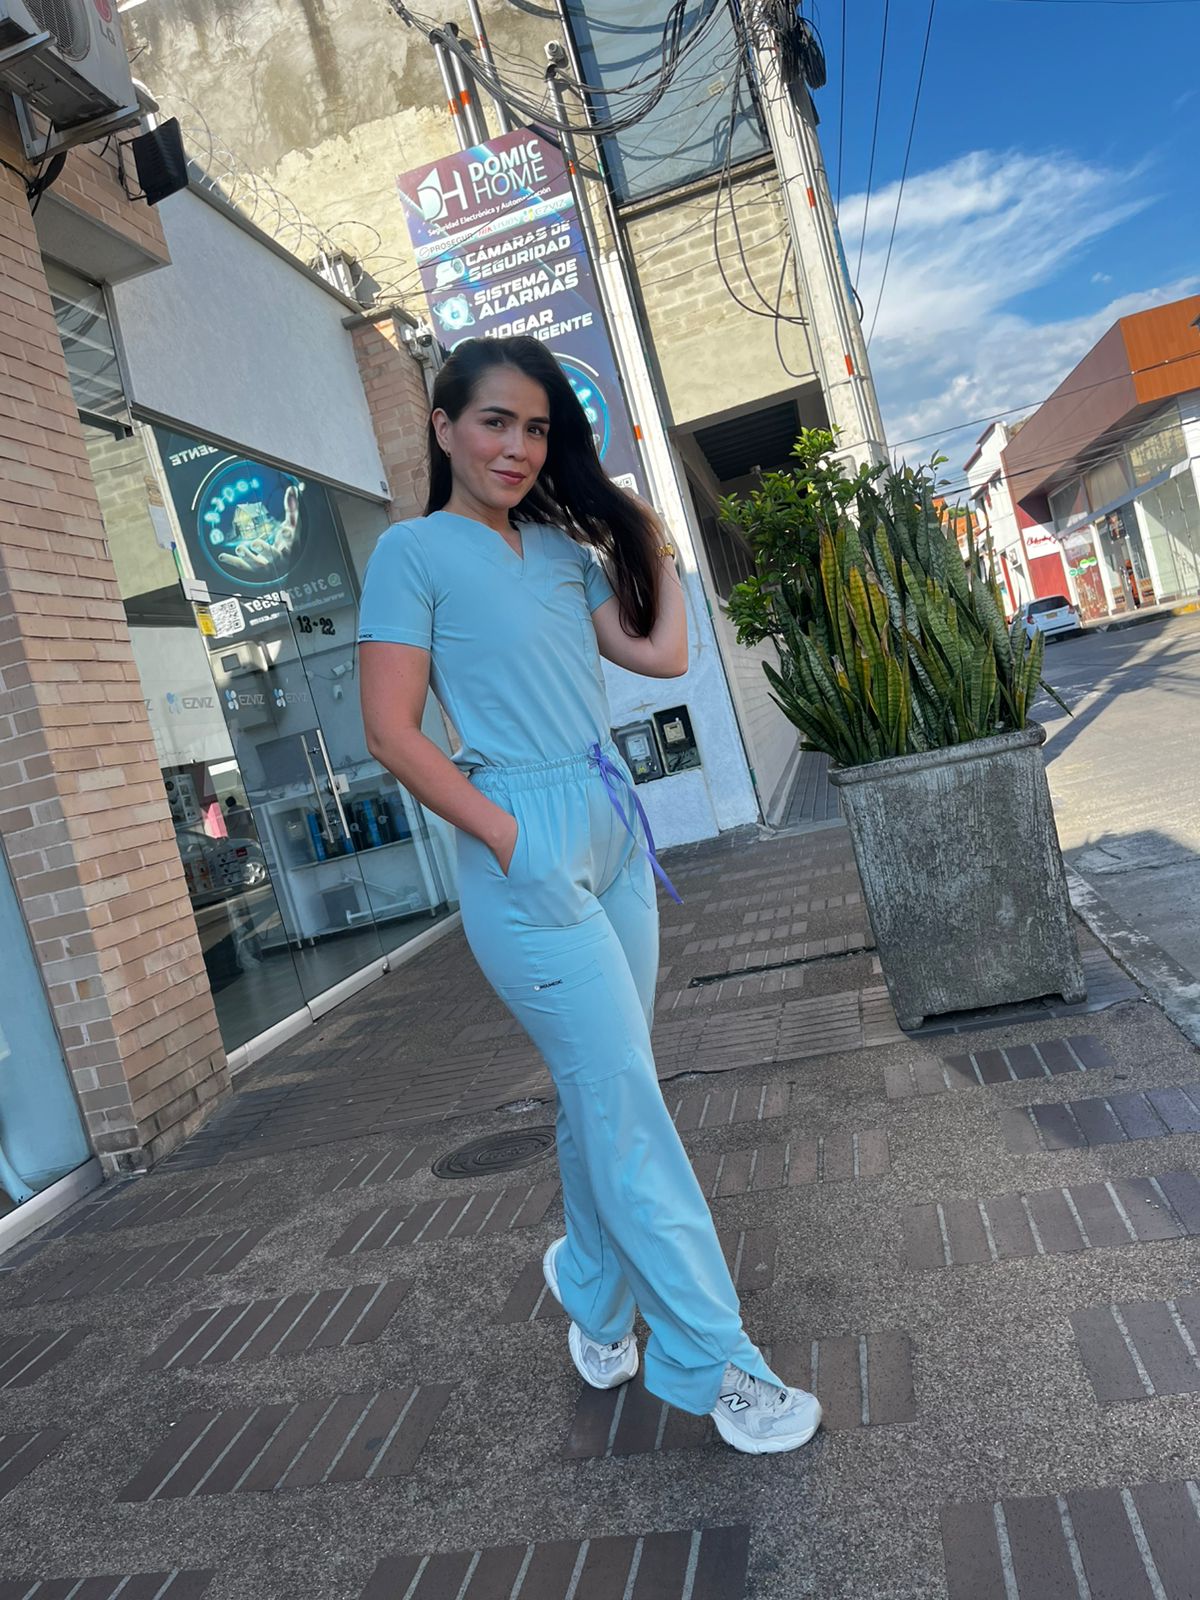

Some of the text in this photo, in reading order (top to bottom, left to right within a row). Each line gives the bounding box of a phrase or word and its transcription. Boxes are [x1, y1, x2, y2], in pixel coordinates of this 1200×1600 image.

[99, 20, 117, 47] LG
[467, 139, 542, 182] DOMIC
[472, 157, 548, 204] HOME
[464, 219, 571, 267] CÁMARAS DE
[467, 234, 571, 283] SEGURIDAD
[473, 258, 577, 306] SISTEMA DE
[478, 272, 579, 321] ALARMAS
[484, 308, 554, 340] HOGAR
[531, 311, 593, 342] IGENTE
[181, 696, 214, 709] EZVIZ
[238, 692, 265, 705] EZVIZ
